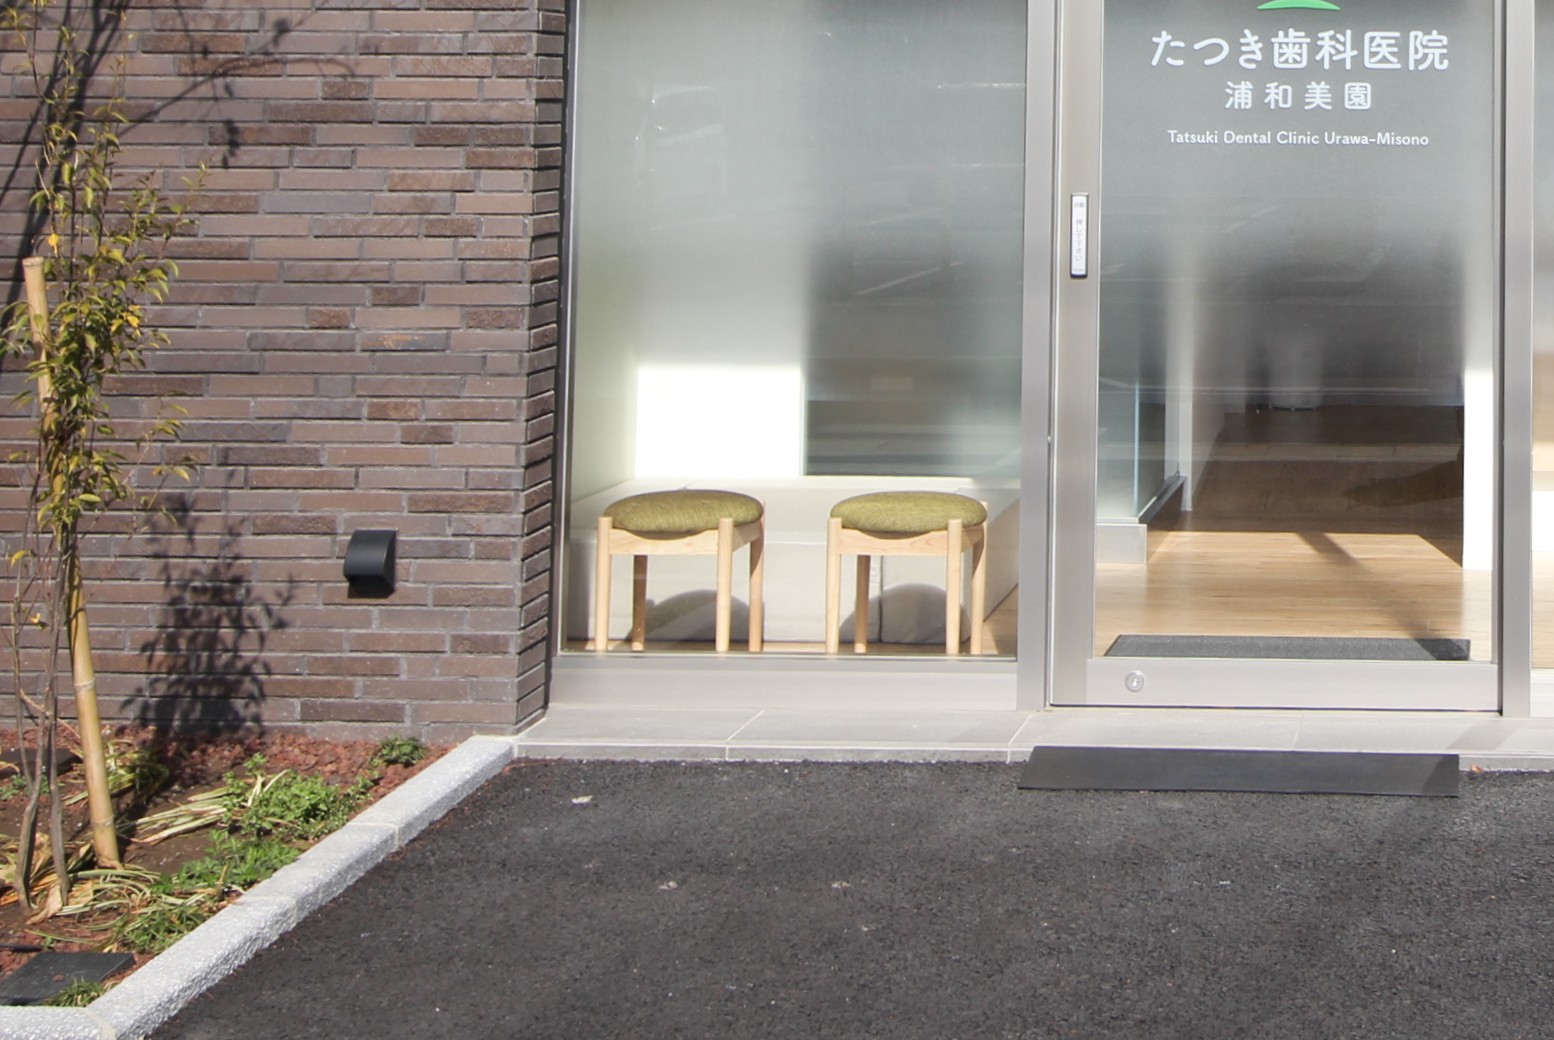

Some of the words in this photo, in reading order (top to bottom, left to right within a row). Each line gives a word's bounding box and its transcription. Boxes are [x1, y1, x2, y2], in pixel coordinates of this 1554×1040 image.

[1151, 28, 1449, 71] たつき歯科医院
[1224, 80, 1372, 110] 浦和美園
[1166, 129, 1219, 144] Tatsuki
[1223, 130, 1272, 145] Dental
[1276, 130, 1320, 145] Clinic
[1324, 131, 1430, 146] Urawa-Misono
